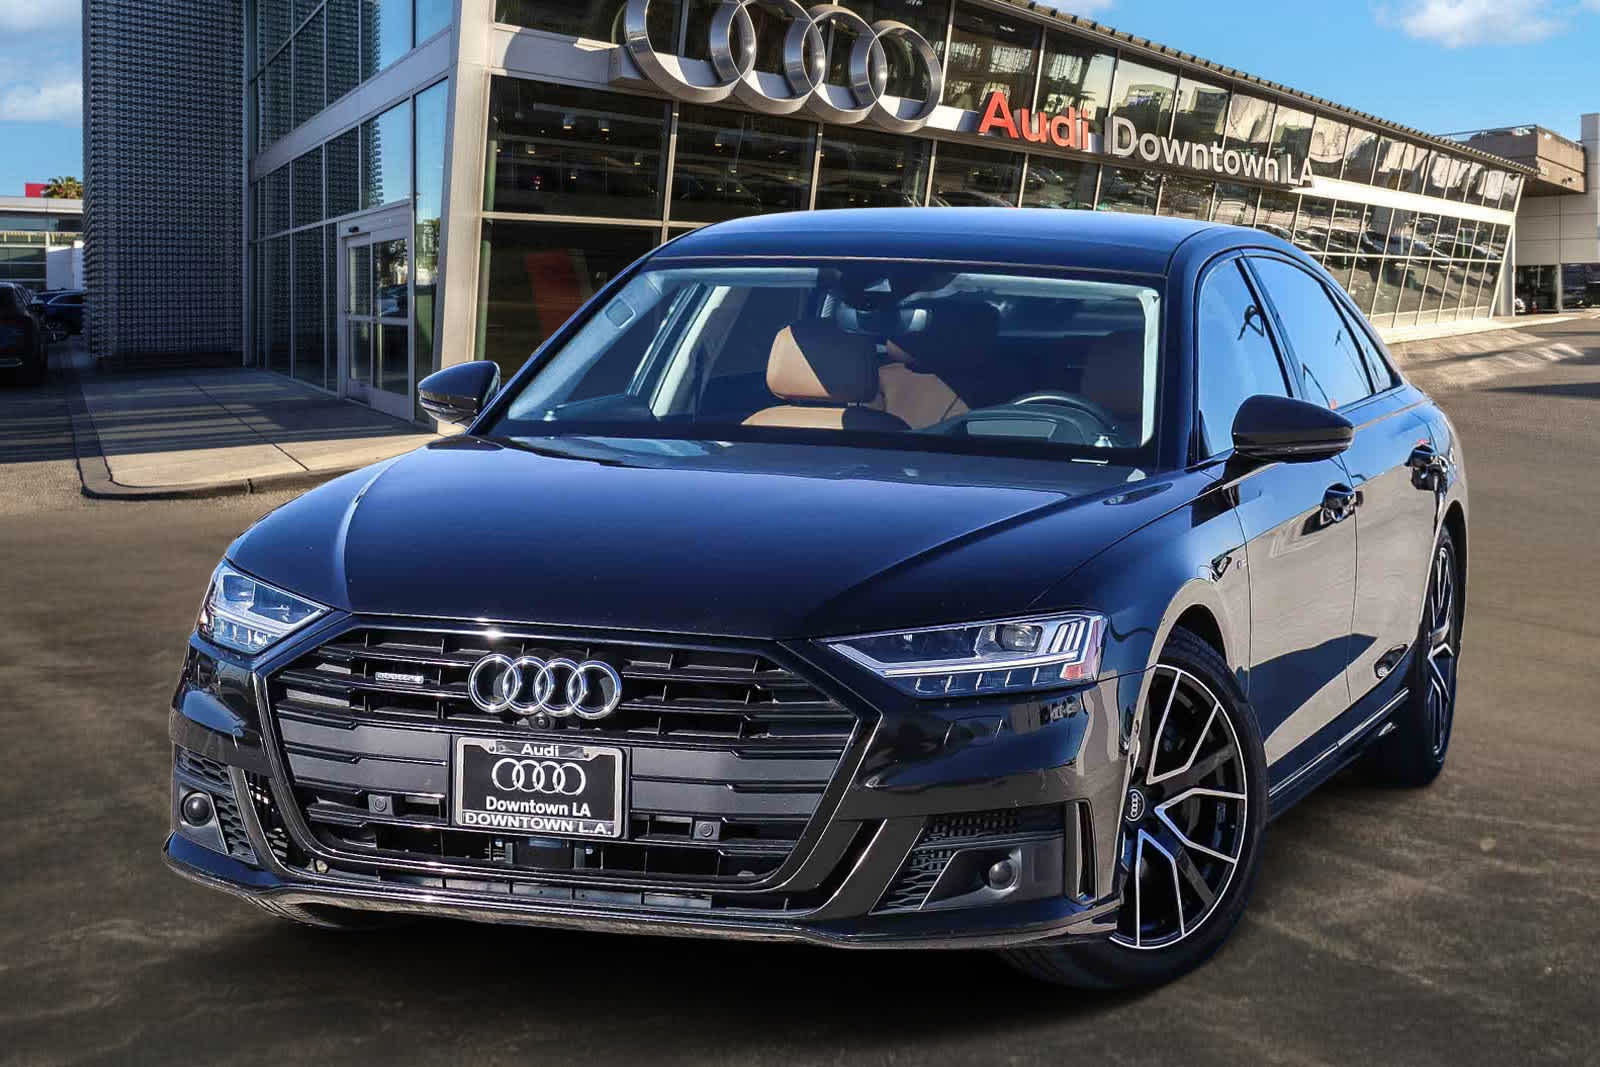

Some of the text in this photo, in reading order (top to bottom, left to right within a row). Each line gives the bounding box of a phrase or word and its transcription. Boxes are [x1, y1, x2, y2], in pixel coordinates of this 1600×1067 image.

[978, 91, 1315, 188] Audi Downtown LA
[521, 744, 560, 757] Audi
[486, 796, 591, 818] Downtown LA
[464, 812, 612, 836] DOWNTOWN L.A.
